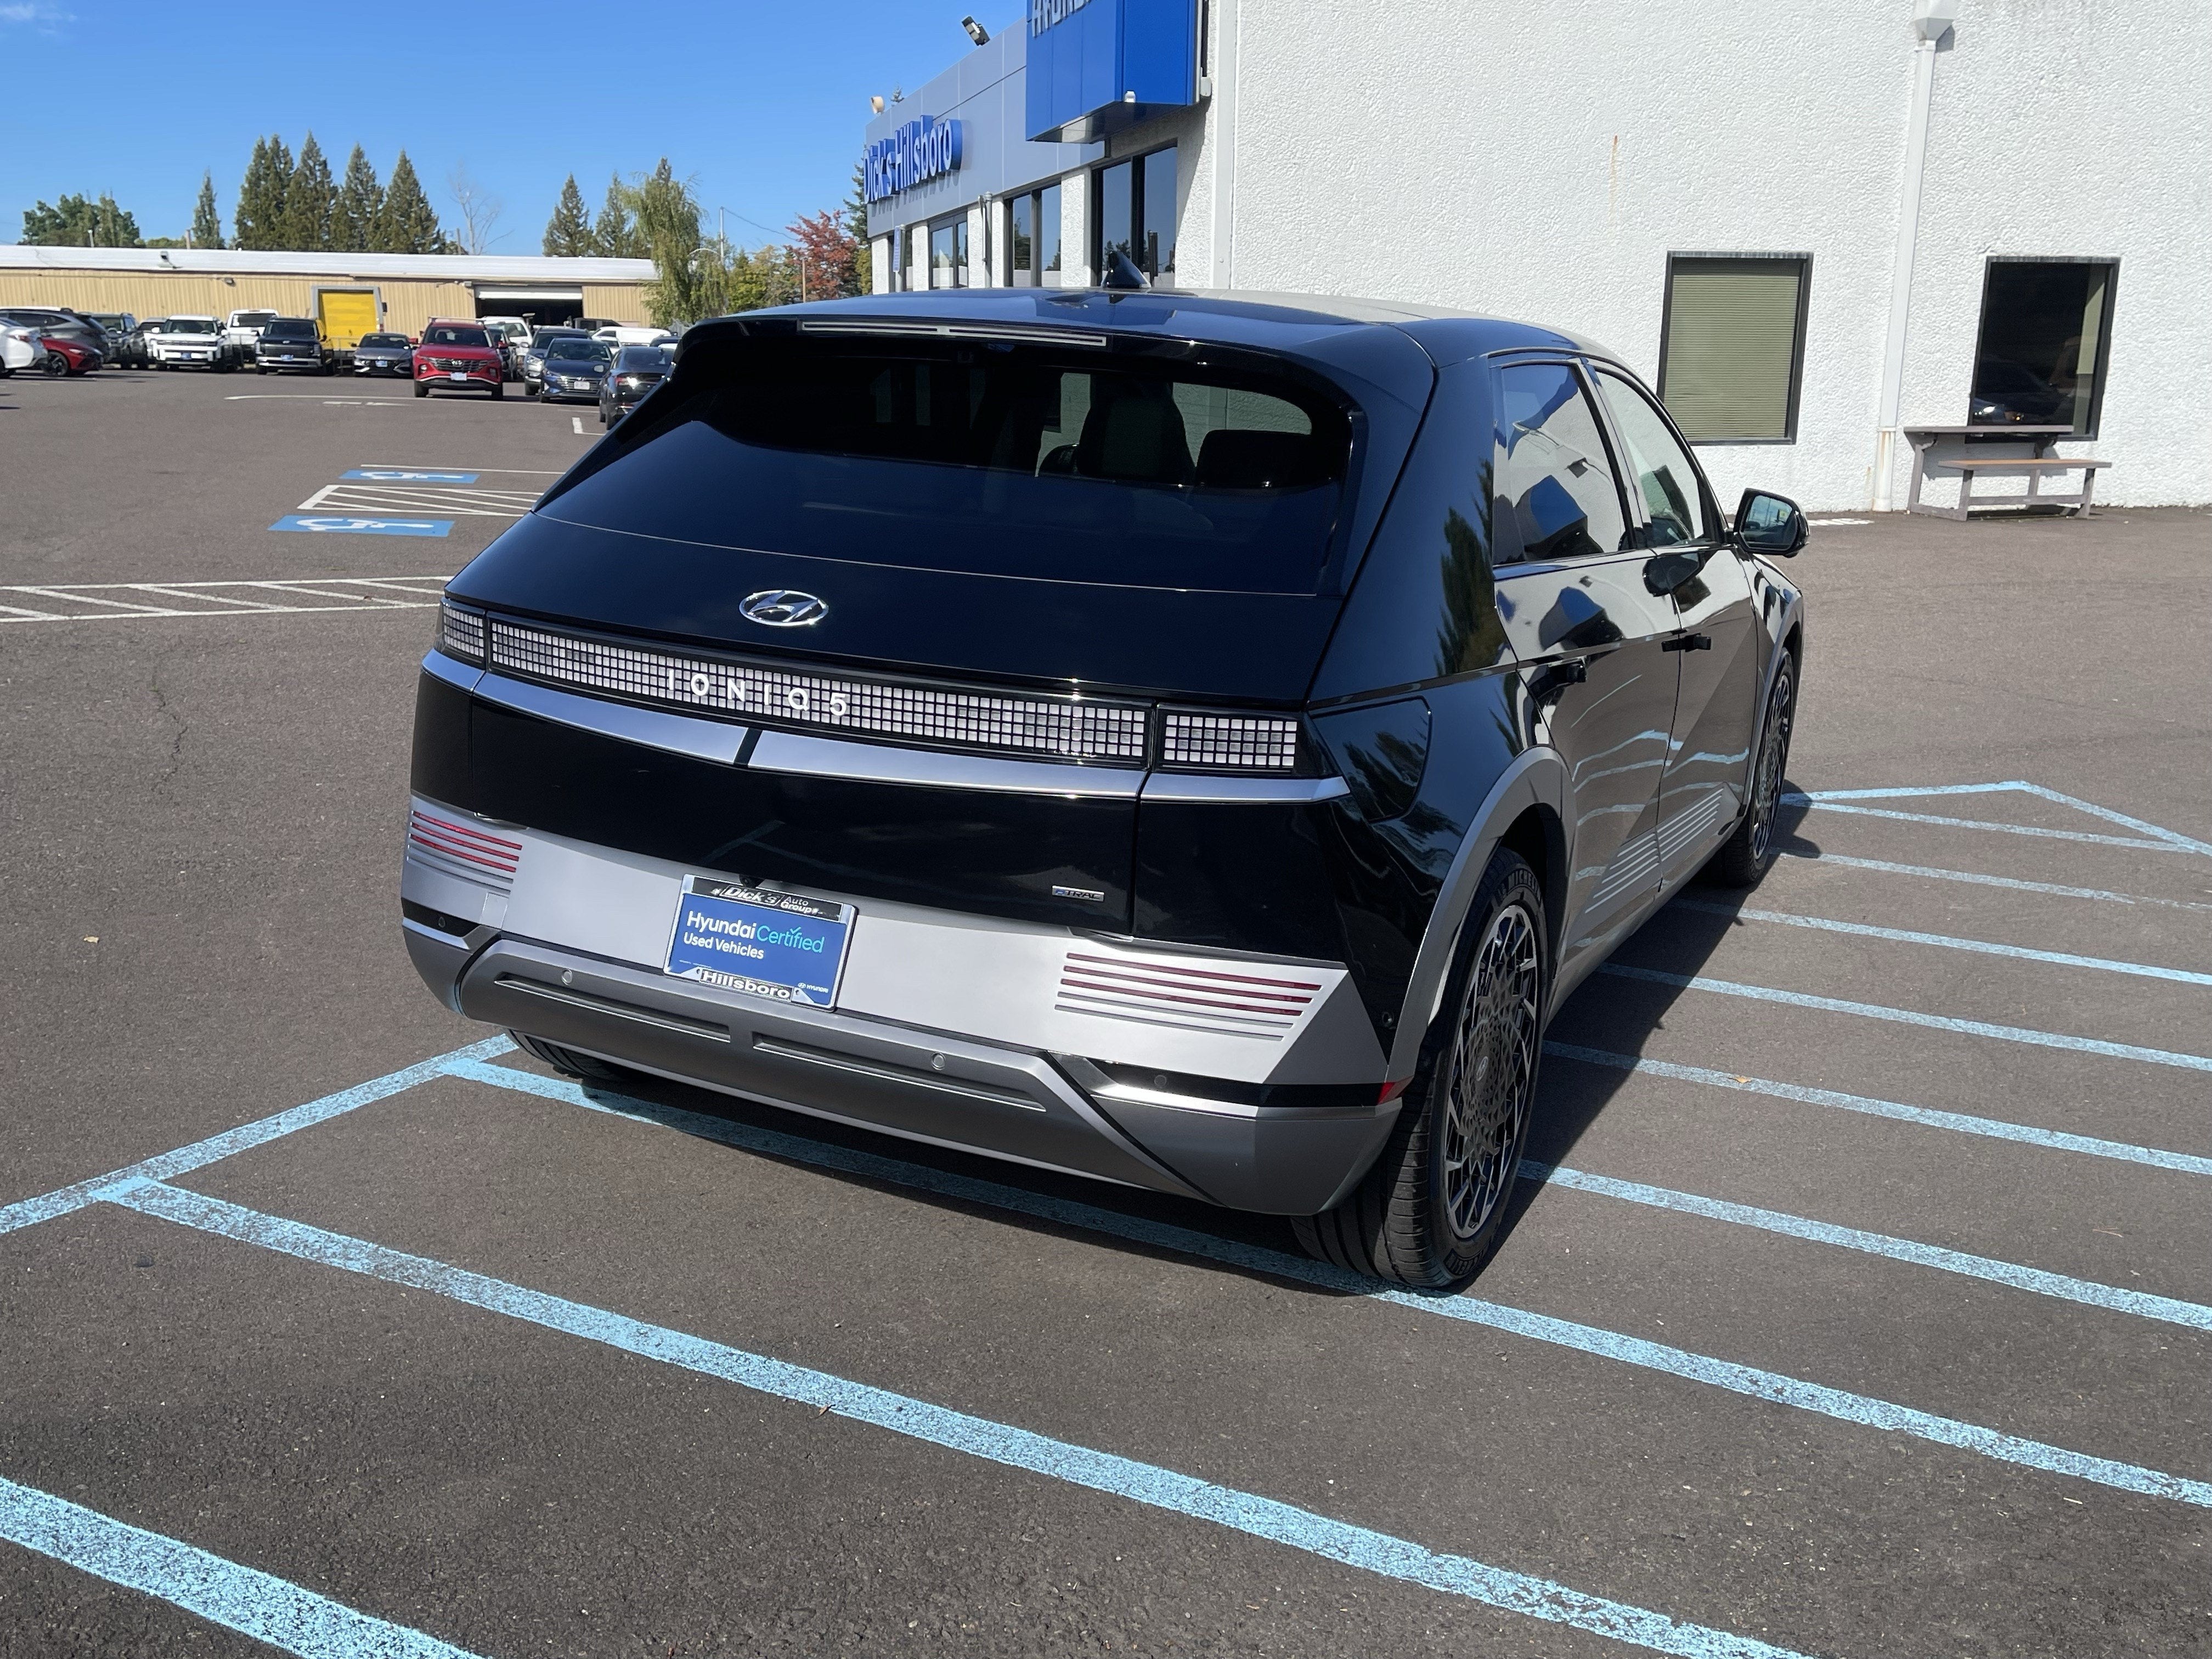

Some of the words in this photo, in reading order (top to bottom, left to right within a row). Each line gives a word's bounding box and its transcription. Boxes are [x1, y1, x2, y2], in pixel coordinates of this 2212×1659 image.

[864, 138, 894, 204] Dick's
[895, 115, 954, 191] Hillsboro
[668, 669, 809, 712] IONIQ
[830, 692, 848, 716] 5
[724, 886, 780, 905] Dick's
[781, 901, 812, 915] Group
[785, 895, 809, 906] Auto
[684, 932, 714, 949] Used
[715, 938, 765, 960] Vehicles
[686, 911, 757, 939] Hyundai
[757, 925, 826, 953] Certified
[701, 970, 791, 1000] Hillsboro
[806, 984, 829, 994] HYUNDAI
